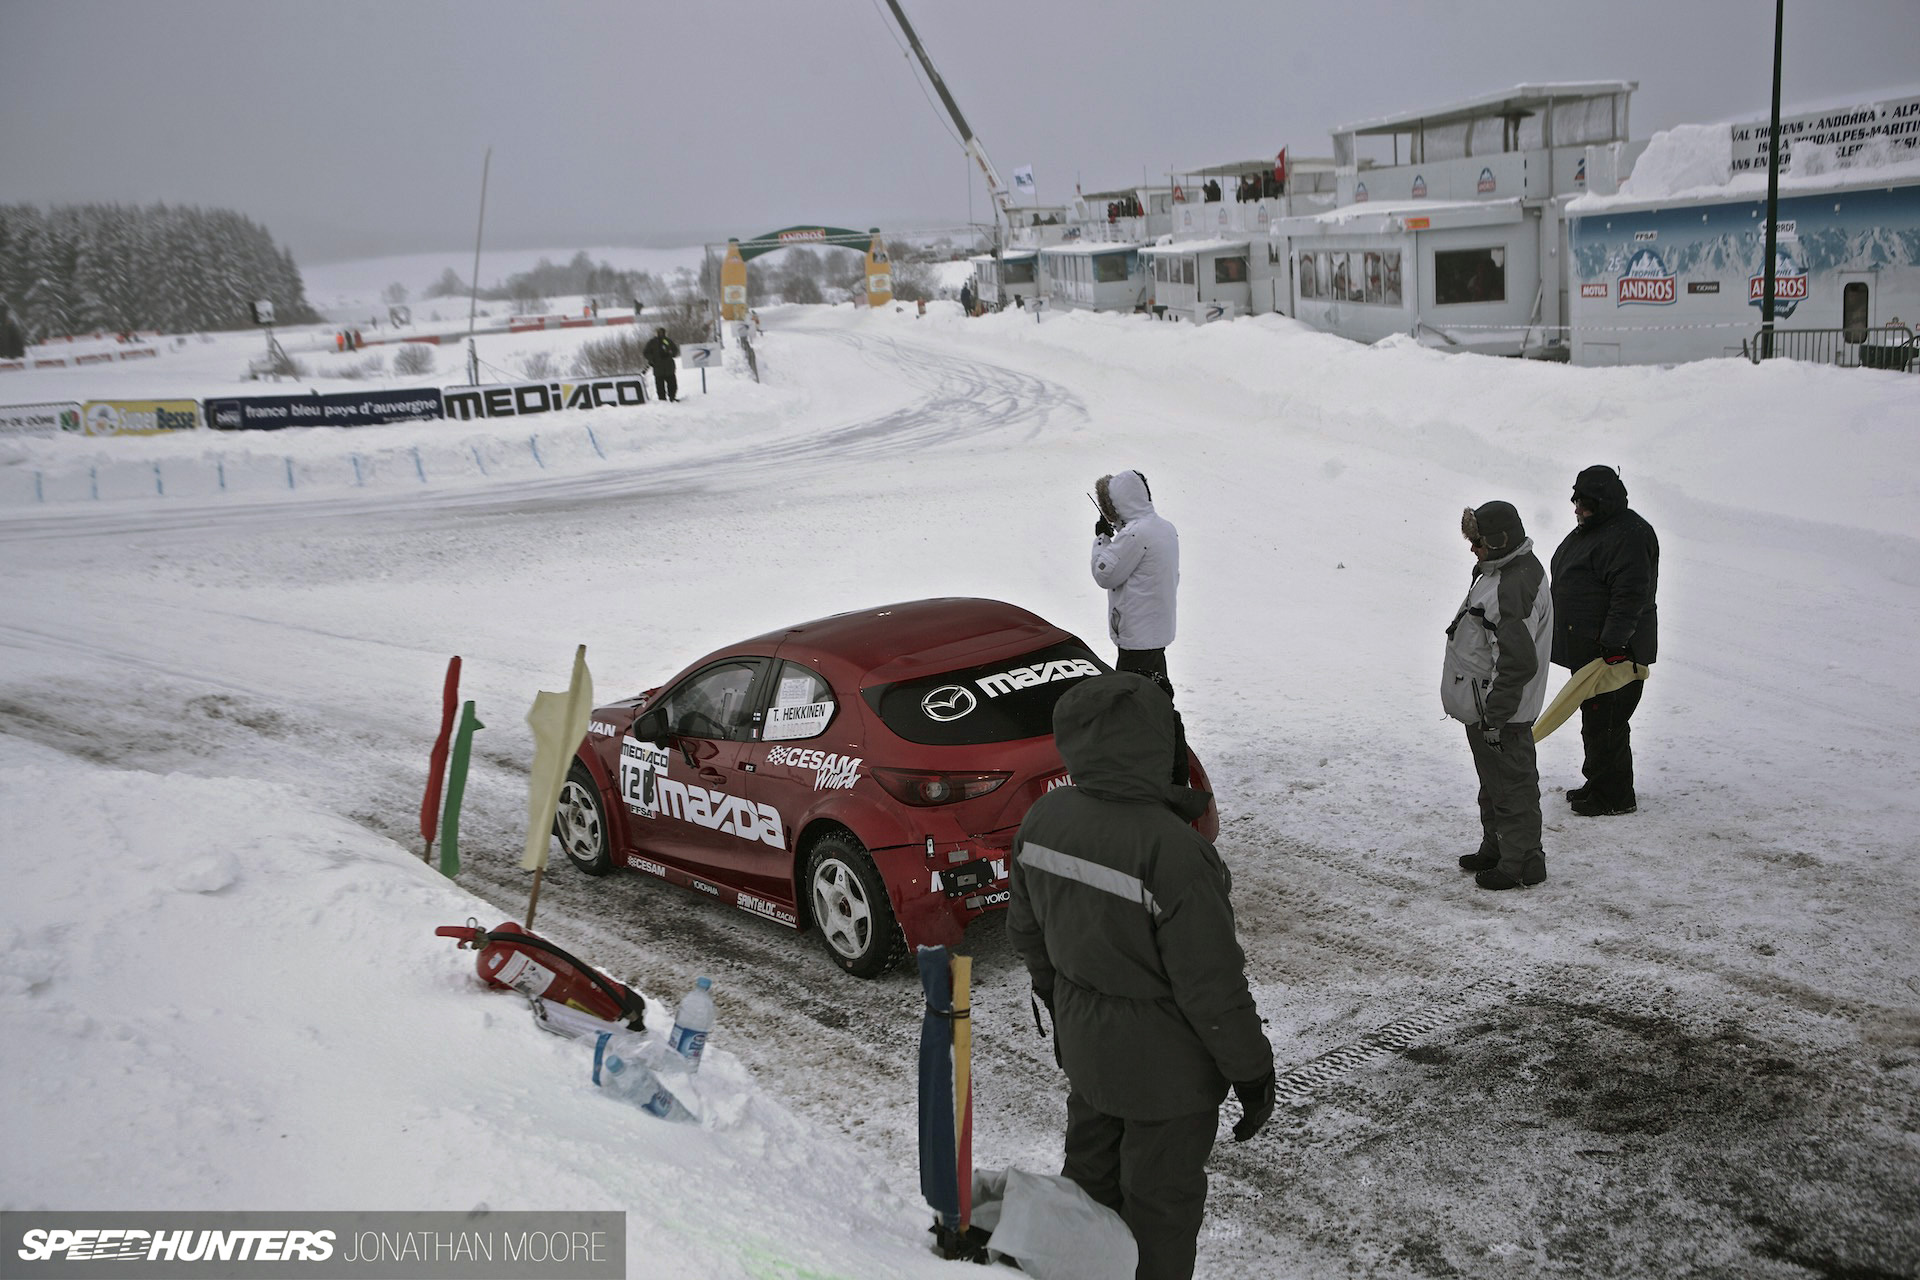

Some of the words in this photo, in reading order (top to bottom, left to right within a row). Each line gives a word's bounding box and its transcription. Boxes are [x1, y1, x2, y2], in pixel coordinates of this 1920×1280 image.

[1816, 110, 1876, 130] ANDORRA
[1891, 103, 1920, 119] ALP
[783, 230, 823, 241] ANDROS
[1583, 285, 1607, 296] MOTUL
[1621, 280, 1673, 299] ANDROS
[245, 404, 288, 418] france
[291, 402, 321, 417] bleu
[324, 402, 358, 418] pays
[359, 399, 438, 417] d'auvergne
[975, 659, 1102, 699] mazda
[773, 709, 779, 722] T.
[782, 703, 826, 721] HEIKKINEN
[785, 748, 863, 775] CESAM
[814, 768, 862, 791] Winter
[631, 805, 653, 818] FFSA
[657, 777, 786, 850] mazda
[636, 858, 666, 878] CESAM
